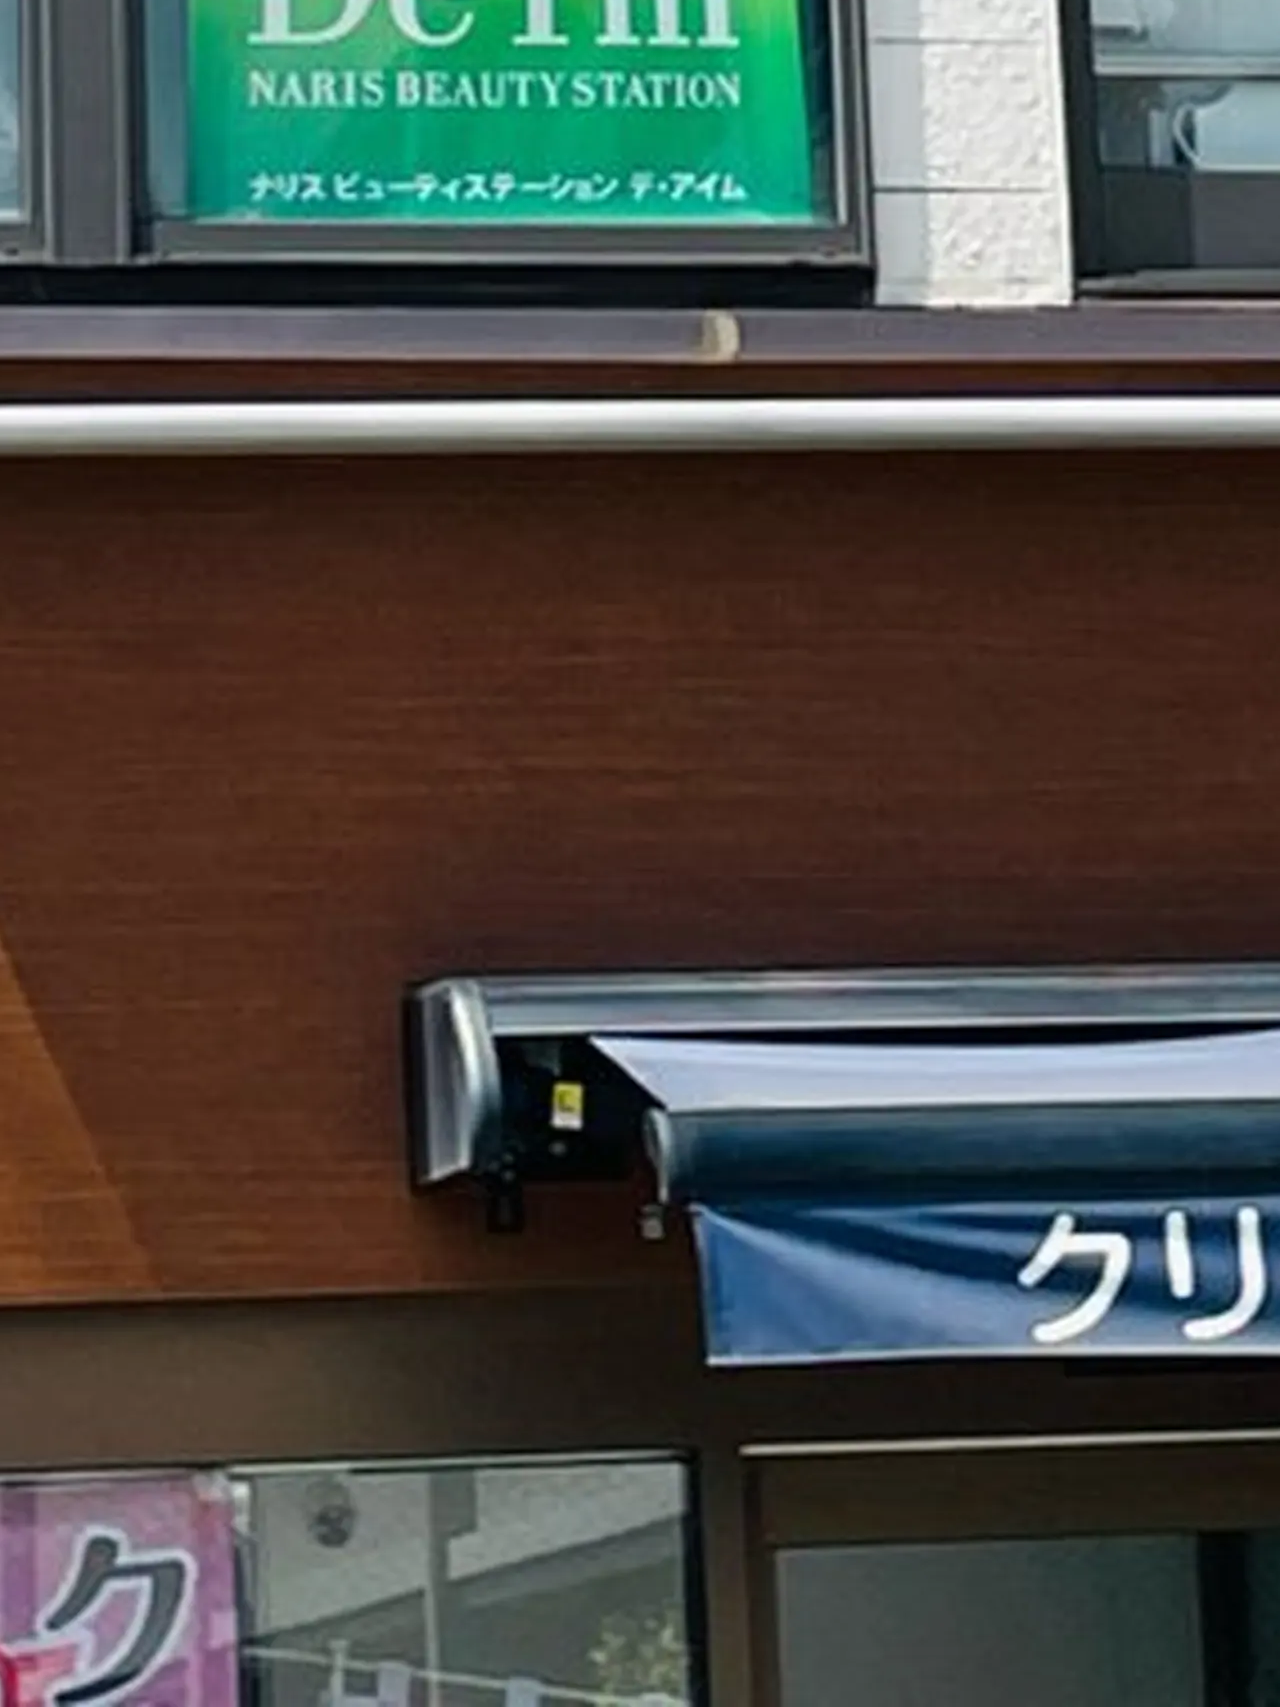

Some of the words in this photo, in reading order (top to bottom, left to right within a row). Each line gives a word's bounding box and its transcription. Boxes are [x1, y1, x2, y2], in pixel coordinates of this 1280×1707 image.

[246, 70, 384, 110] NARIS
[395, 70, 567, 110] BEAUTY
[571, 71, 741, 110] STATION
[247, 171, 325, 203] ナリス
[333, 172, 619, 204] ビューティステーション
[629, 173, 747, 204] デ・アイム
